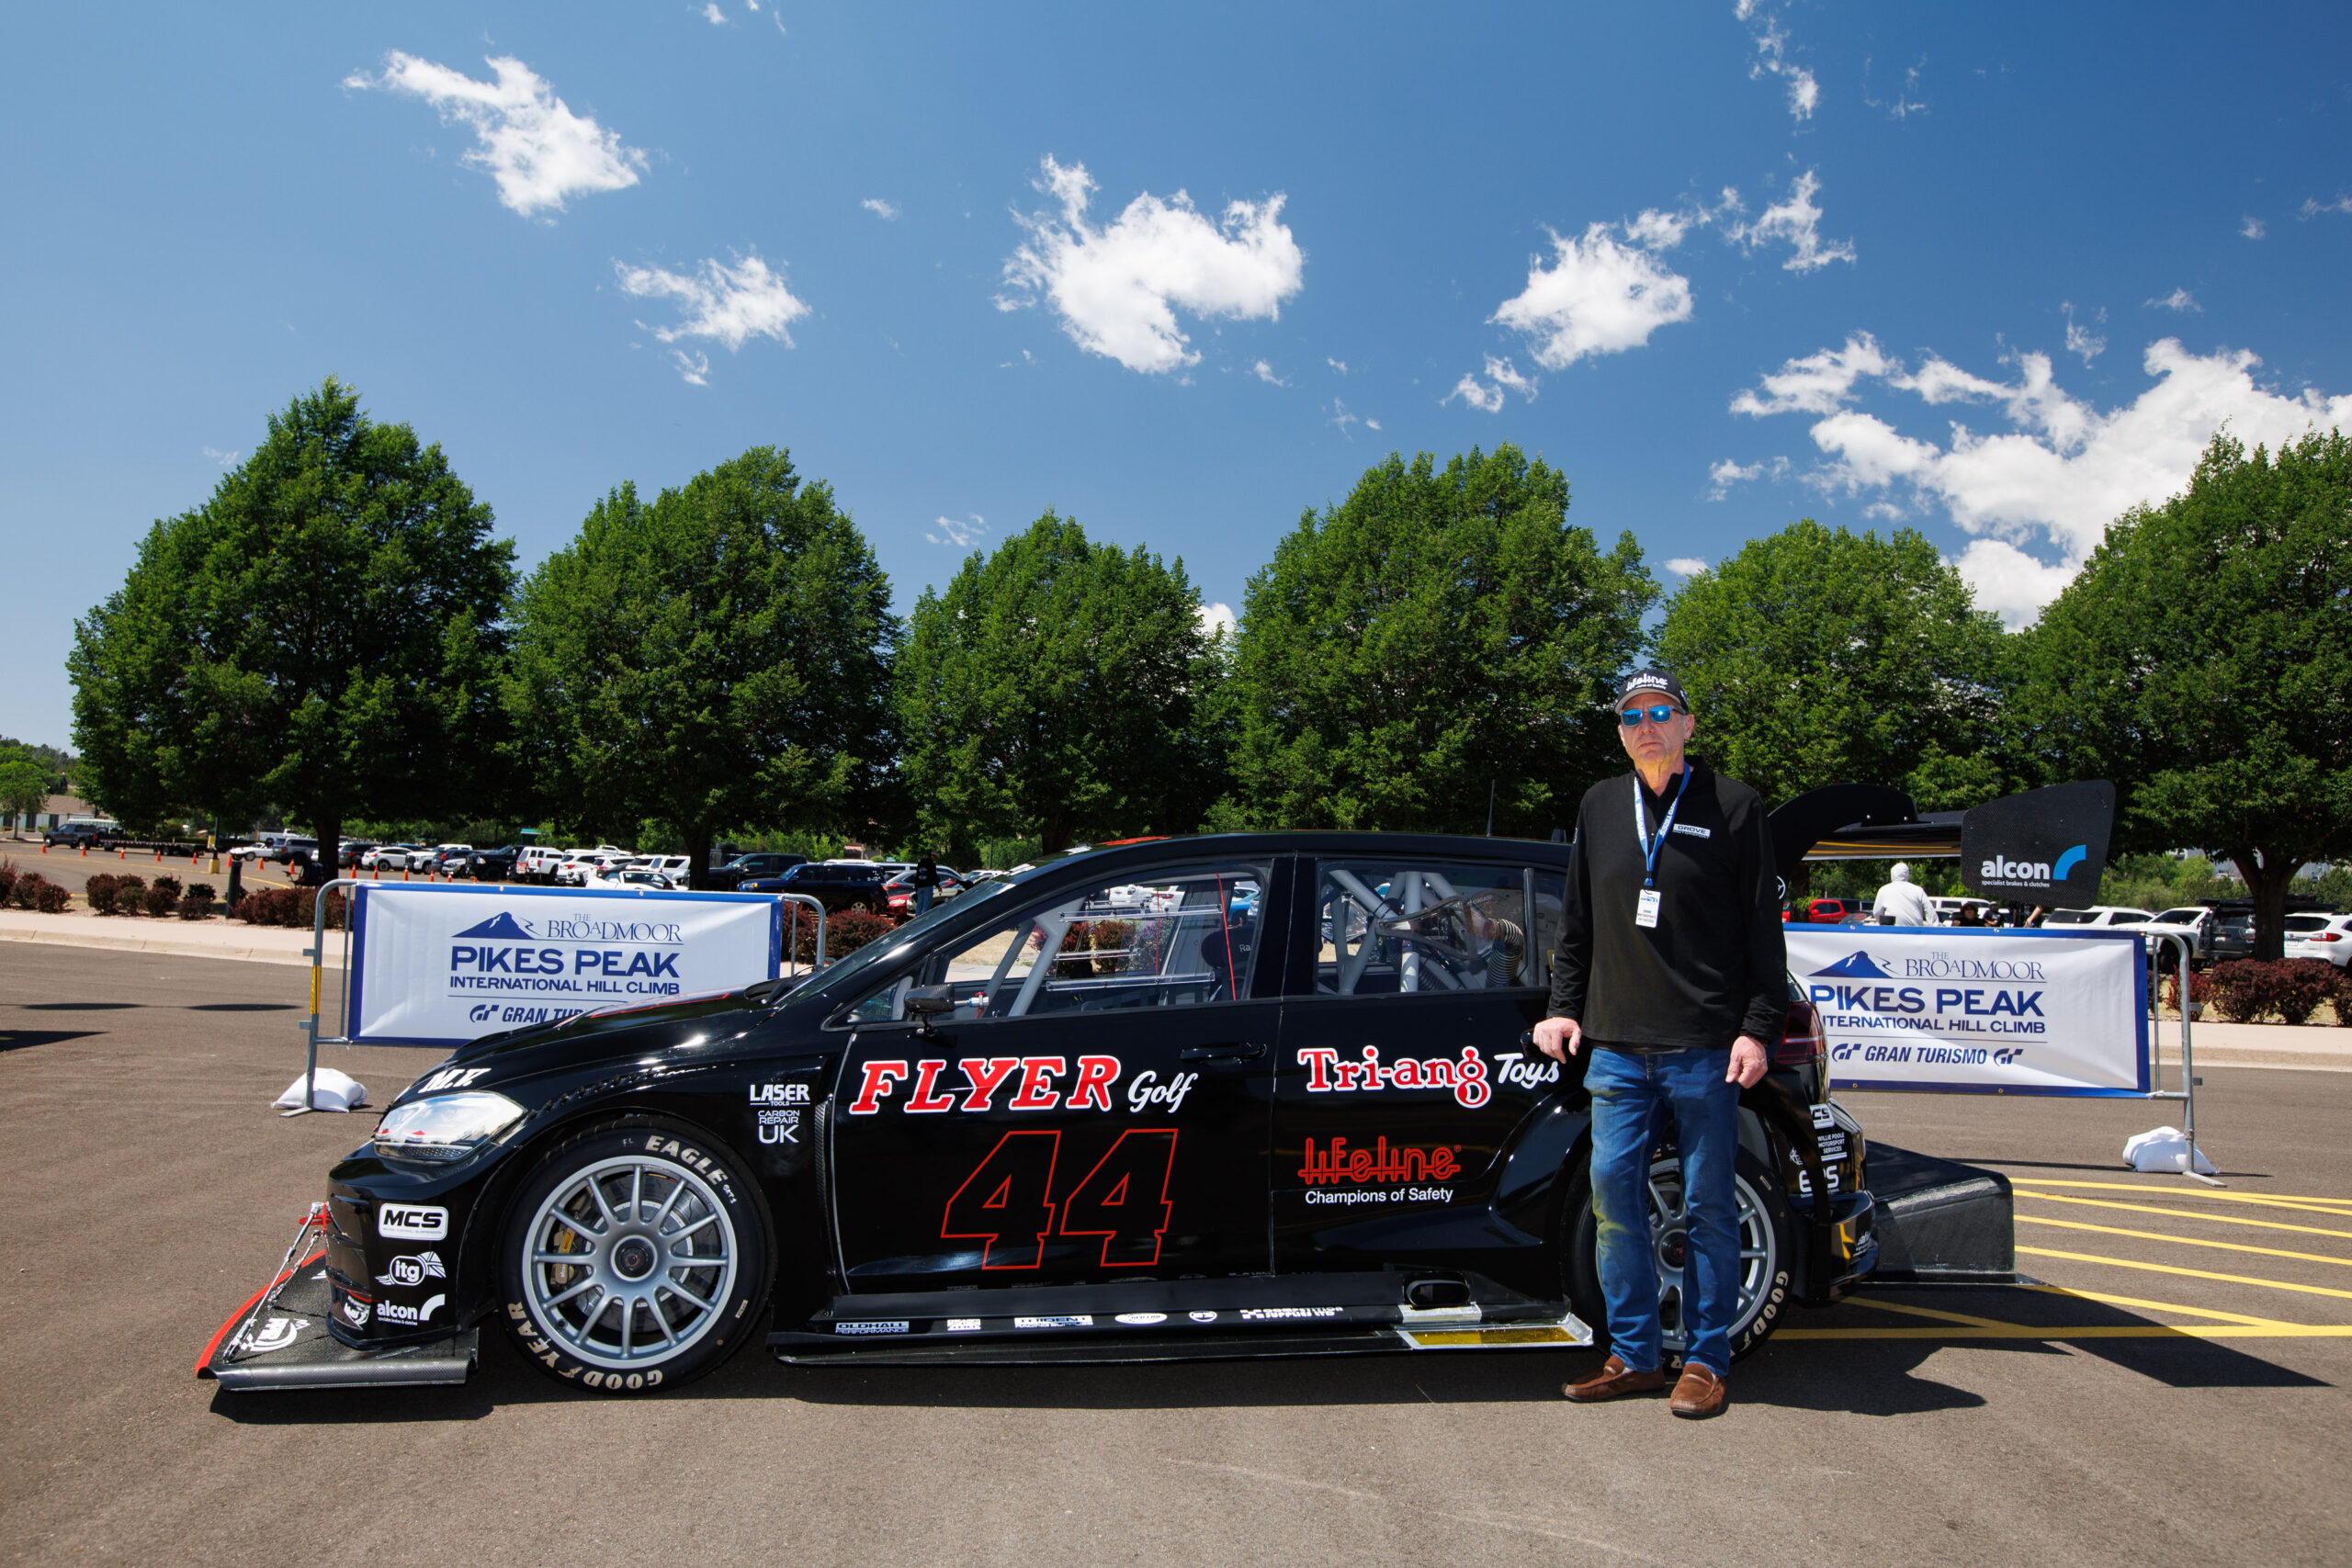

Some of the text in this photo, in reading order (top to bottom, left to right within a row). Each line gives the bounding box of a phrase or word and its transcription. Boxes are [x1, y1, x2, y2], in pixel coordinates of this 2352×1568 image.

[1678, 826, 1706, 834] GROVE
[1981, 855, 2050, 880] alcon
[573, 913, 591, 921] THE
[547, 920, 682, 942] BROADMOOR
[451, 945, 680, 977] PIKES PEAK
[1930, 952, 1950, 960] THE
[1905, 959, 2045, 979] BROADMOOR
[450, 976, 680, 996] INTERNATIONAL HILL CLIMB
[1810, 985, 2045, 1017] PIKES PEAK
[502, 1006, 548, 1023] GRAN
[1823, 1015, 2045, 1033] TERNATIONAL HILL CLIMB
[1865, 1045, 1912, 1062] GRAN
[1917, 1047, 1986, 1065] TURISMO
[848, 1055, 1199, 1115] FLYER Golf
[1297, 1044, 1560, 1109] Tri-ang Toys
[750, 1084, 810, 1101] LASER
[759, 1116, 799, 1124] REPAIR
[1812, 1107, 1830, 1120] CS
[758, 1124, 799, 1144] UK
[1818, 1138, 1845, 1147] MOTORSPORT
[645, 1134, 729, 1185] EAGLE
[1799, 1165, 1839, 1192] ES
[940, 1128, 1179, 1270] 44
[1305, 1188, 1453, 1205] Champions of Safety
[384, 1210, 443, 1228] MCS
[395, 1259, 420, 1282] itg
[377, 1300, 418, 1320] alcon
